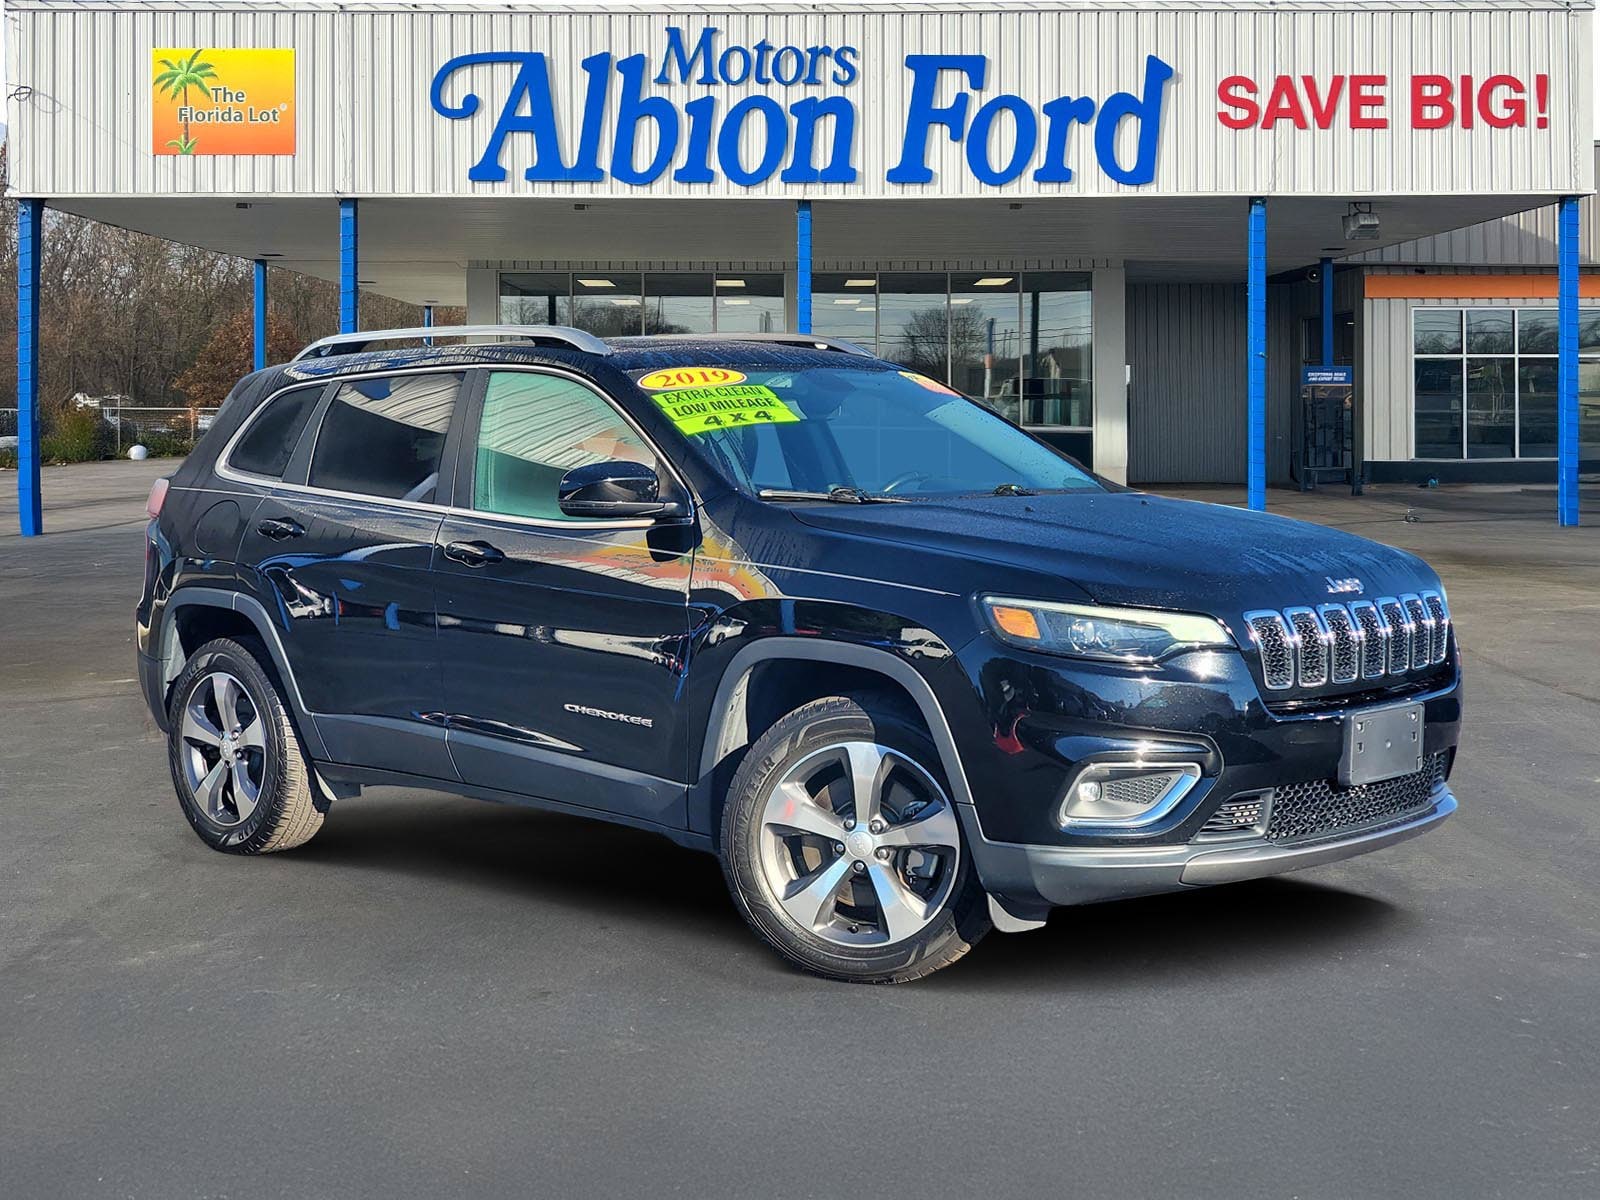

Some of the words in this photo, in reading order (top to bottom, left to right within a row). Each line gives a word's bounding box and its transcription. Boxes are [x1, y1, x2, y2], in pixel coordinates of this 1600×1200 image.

[653, 26, 858, 86] Motors
[211, 86, 246, 103] The
[1217, 75, 1388, 130] SAVE
[1410, 74, 1549, 130] BIG!
[178, 106, 244, 122] Florida
[248, 106, 279, 122] Lot
[430, 52, 857, 187] Albion
[886, 54, 1175, 187] Ford
[656, 370, 731, 388] 2019
[663, 388, 713, 404] EXTRA
[715, 385, 764, 397] CLEAN
[672, 401, 709, 417] LOW
[708, 396, 776, 411] MILEAGE
[563, 703, 653, 728] CHEROKEE
